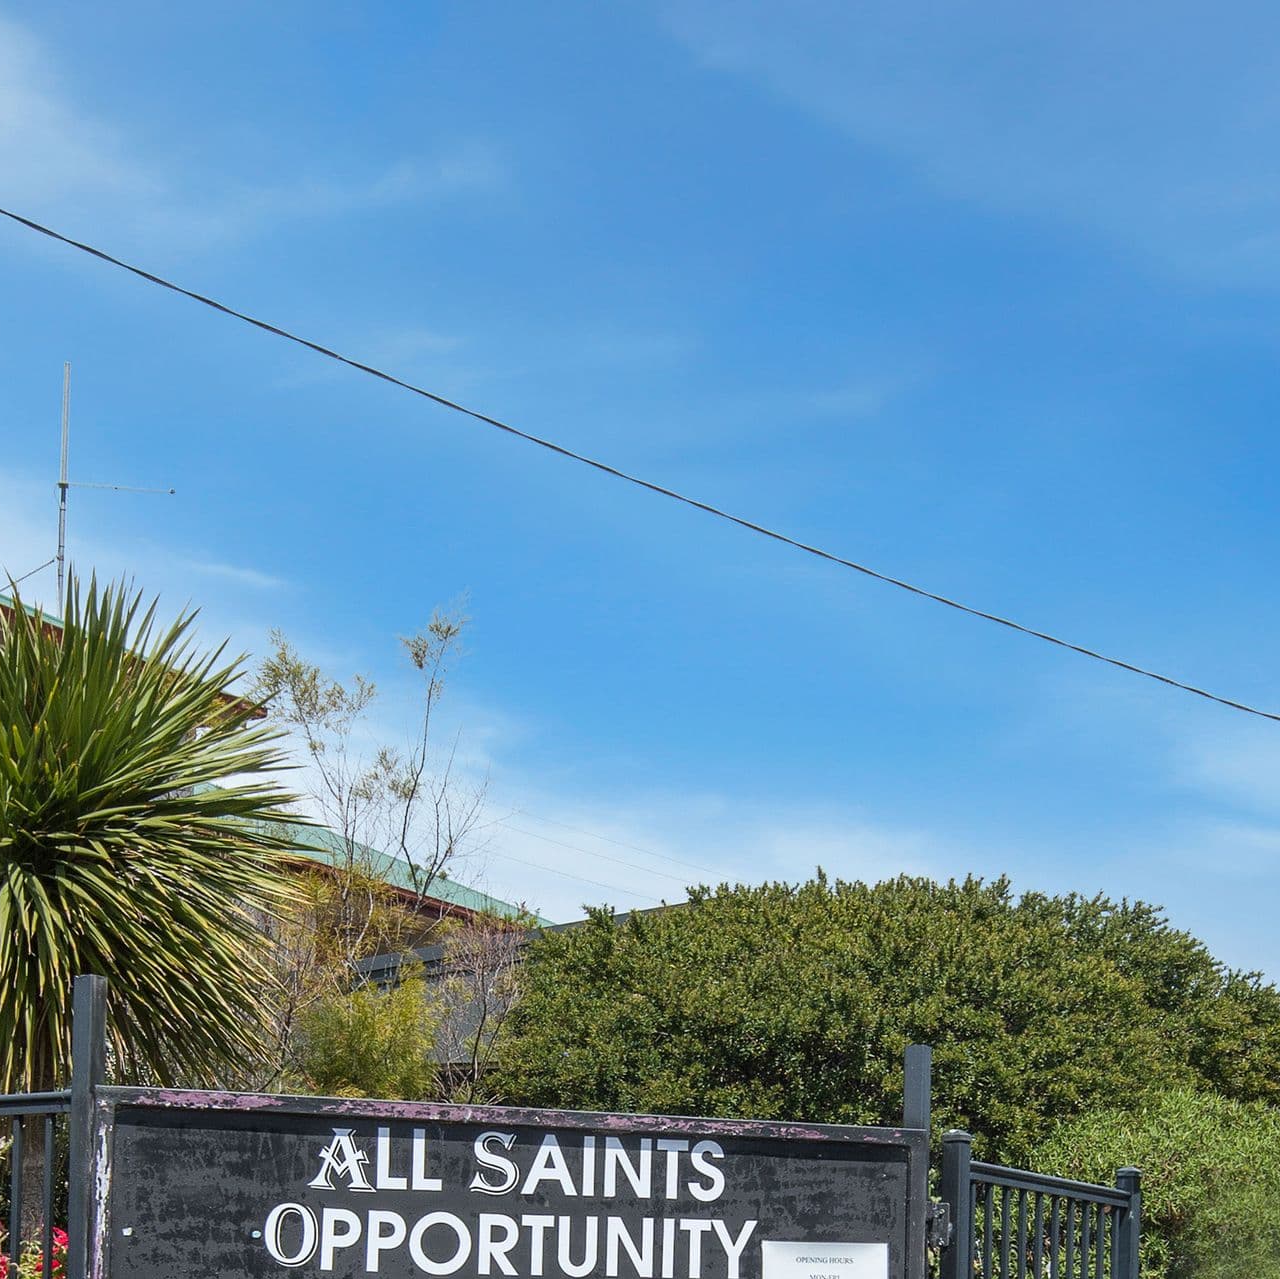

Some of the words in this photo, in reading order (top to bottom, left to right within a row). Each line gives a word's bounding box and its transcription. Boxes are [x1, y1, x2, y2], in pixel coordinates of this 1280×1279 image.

[307, 1127, 443, 1194] ALL
[469, 1131, 726, 1202] SAINTS
[264, 1202, 758, 1279] OPPORTUNITY
[795, 1256, 828, 1264] OPENING
[829, 1256, 854, 1265] HOURS
